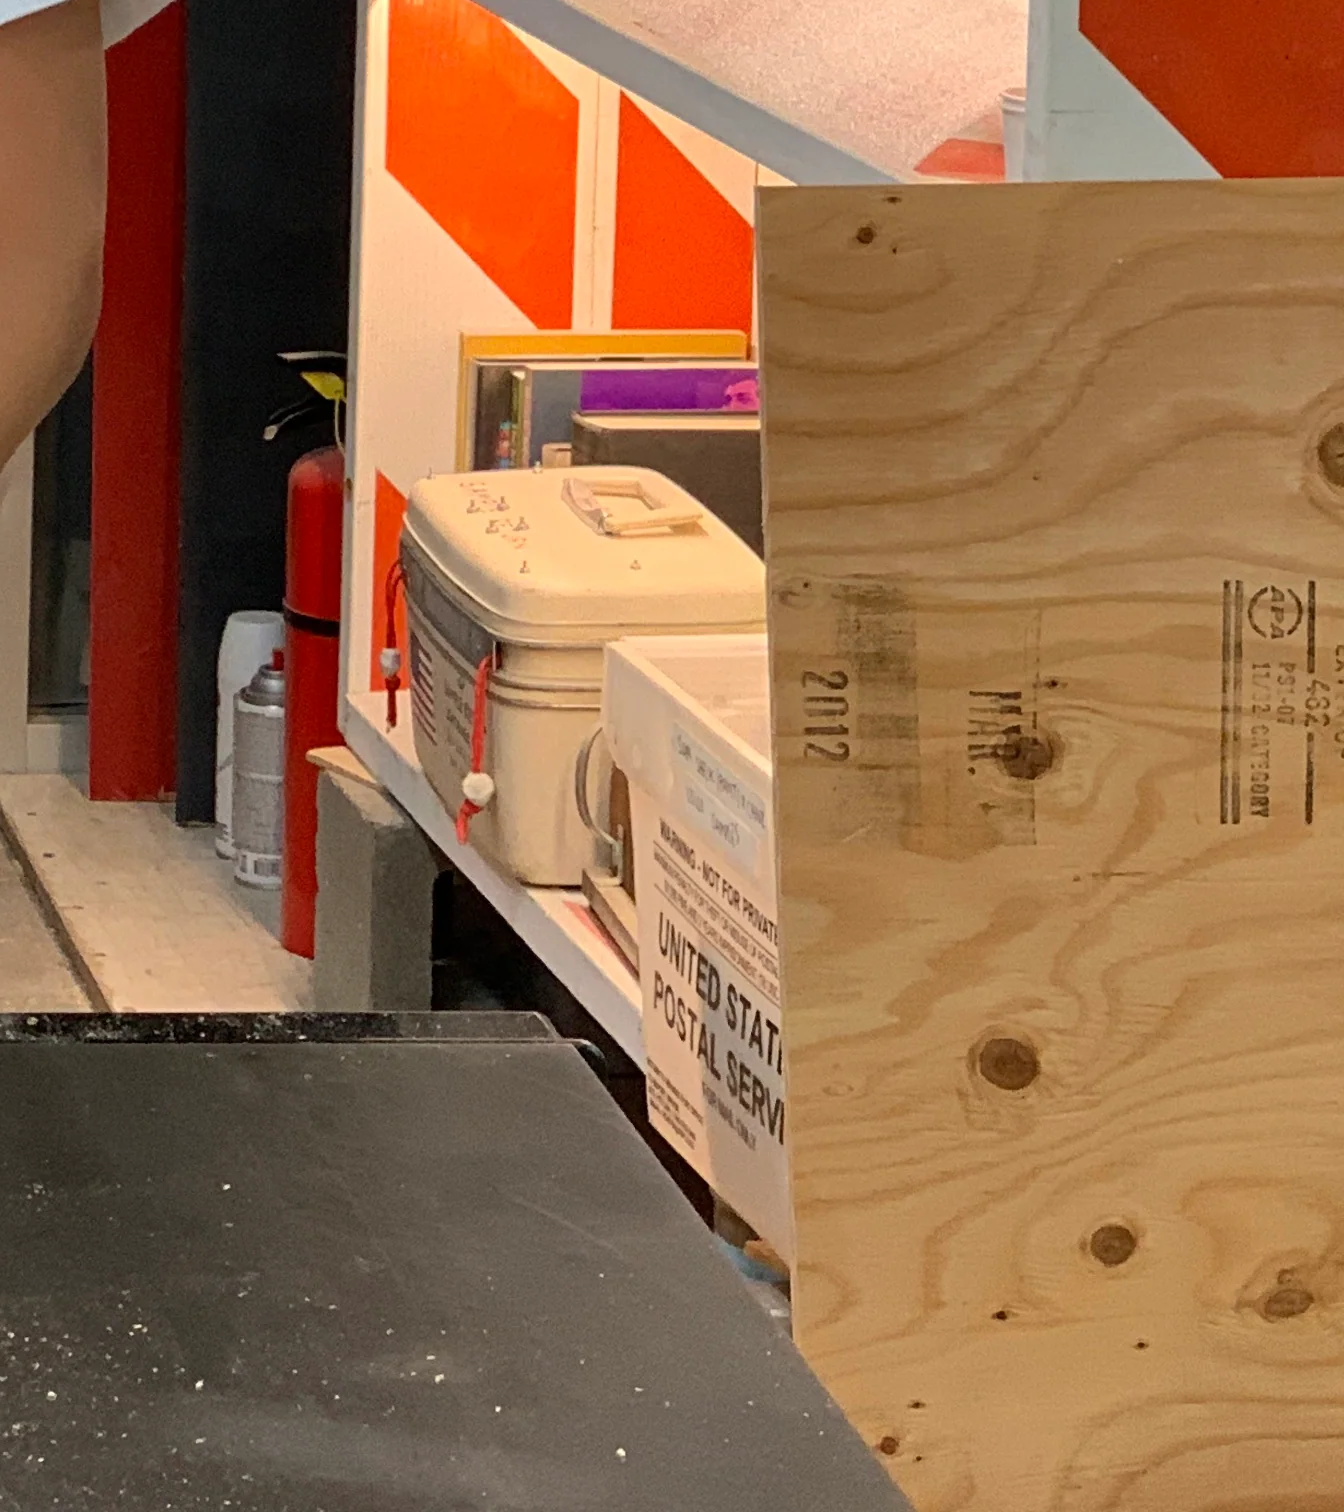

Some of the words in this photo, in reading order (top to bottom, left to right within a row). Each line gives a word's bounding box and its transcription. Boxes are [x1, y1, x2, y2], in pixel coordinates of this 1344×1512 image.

[1270, 585, 1285, 639] APA
[802, 670, 850, 762] 2012
[1250, 723, 1271, 818] CATEGORY
[702, 859, 720, 893] NOT
[722, 878, 740, 912] FOR
[658, 910, 721, 1011] UNITED
[653, 970, 721, 1081] POSTAL
